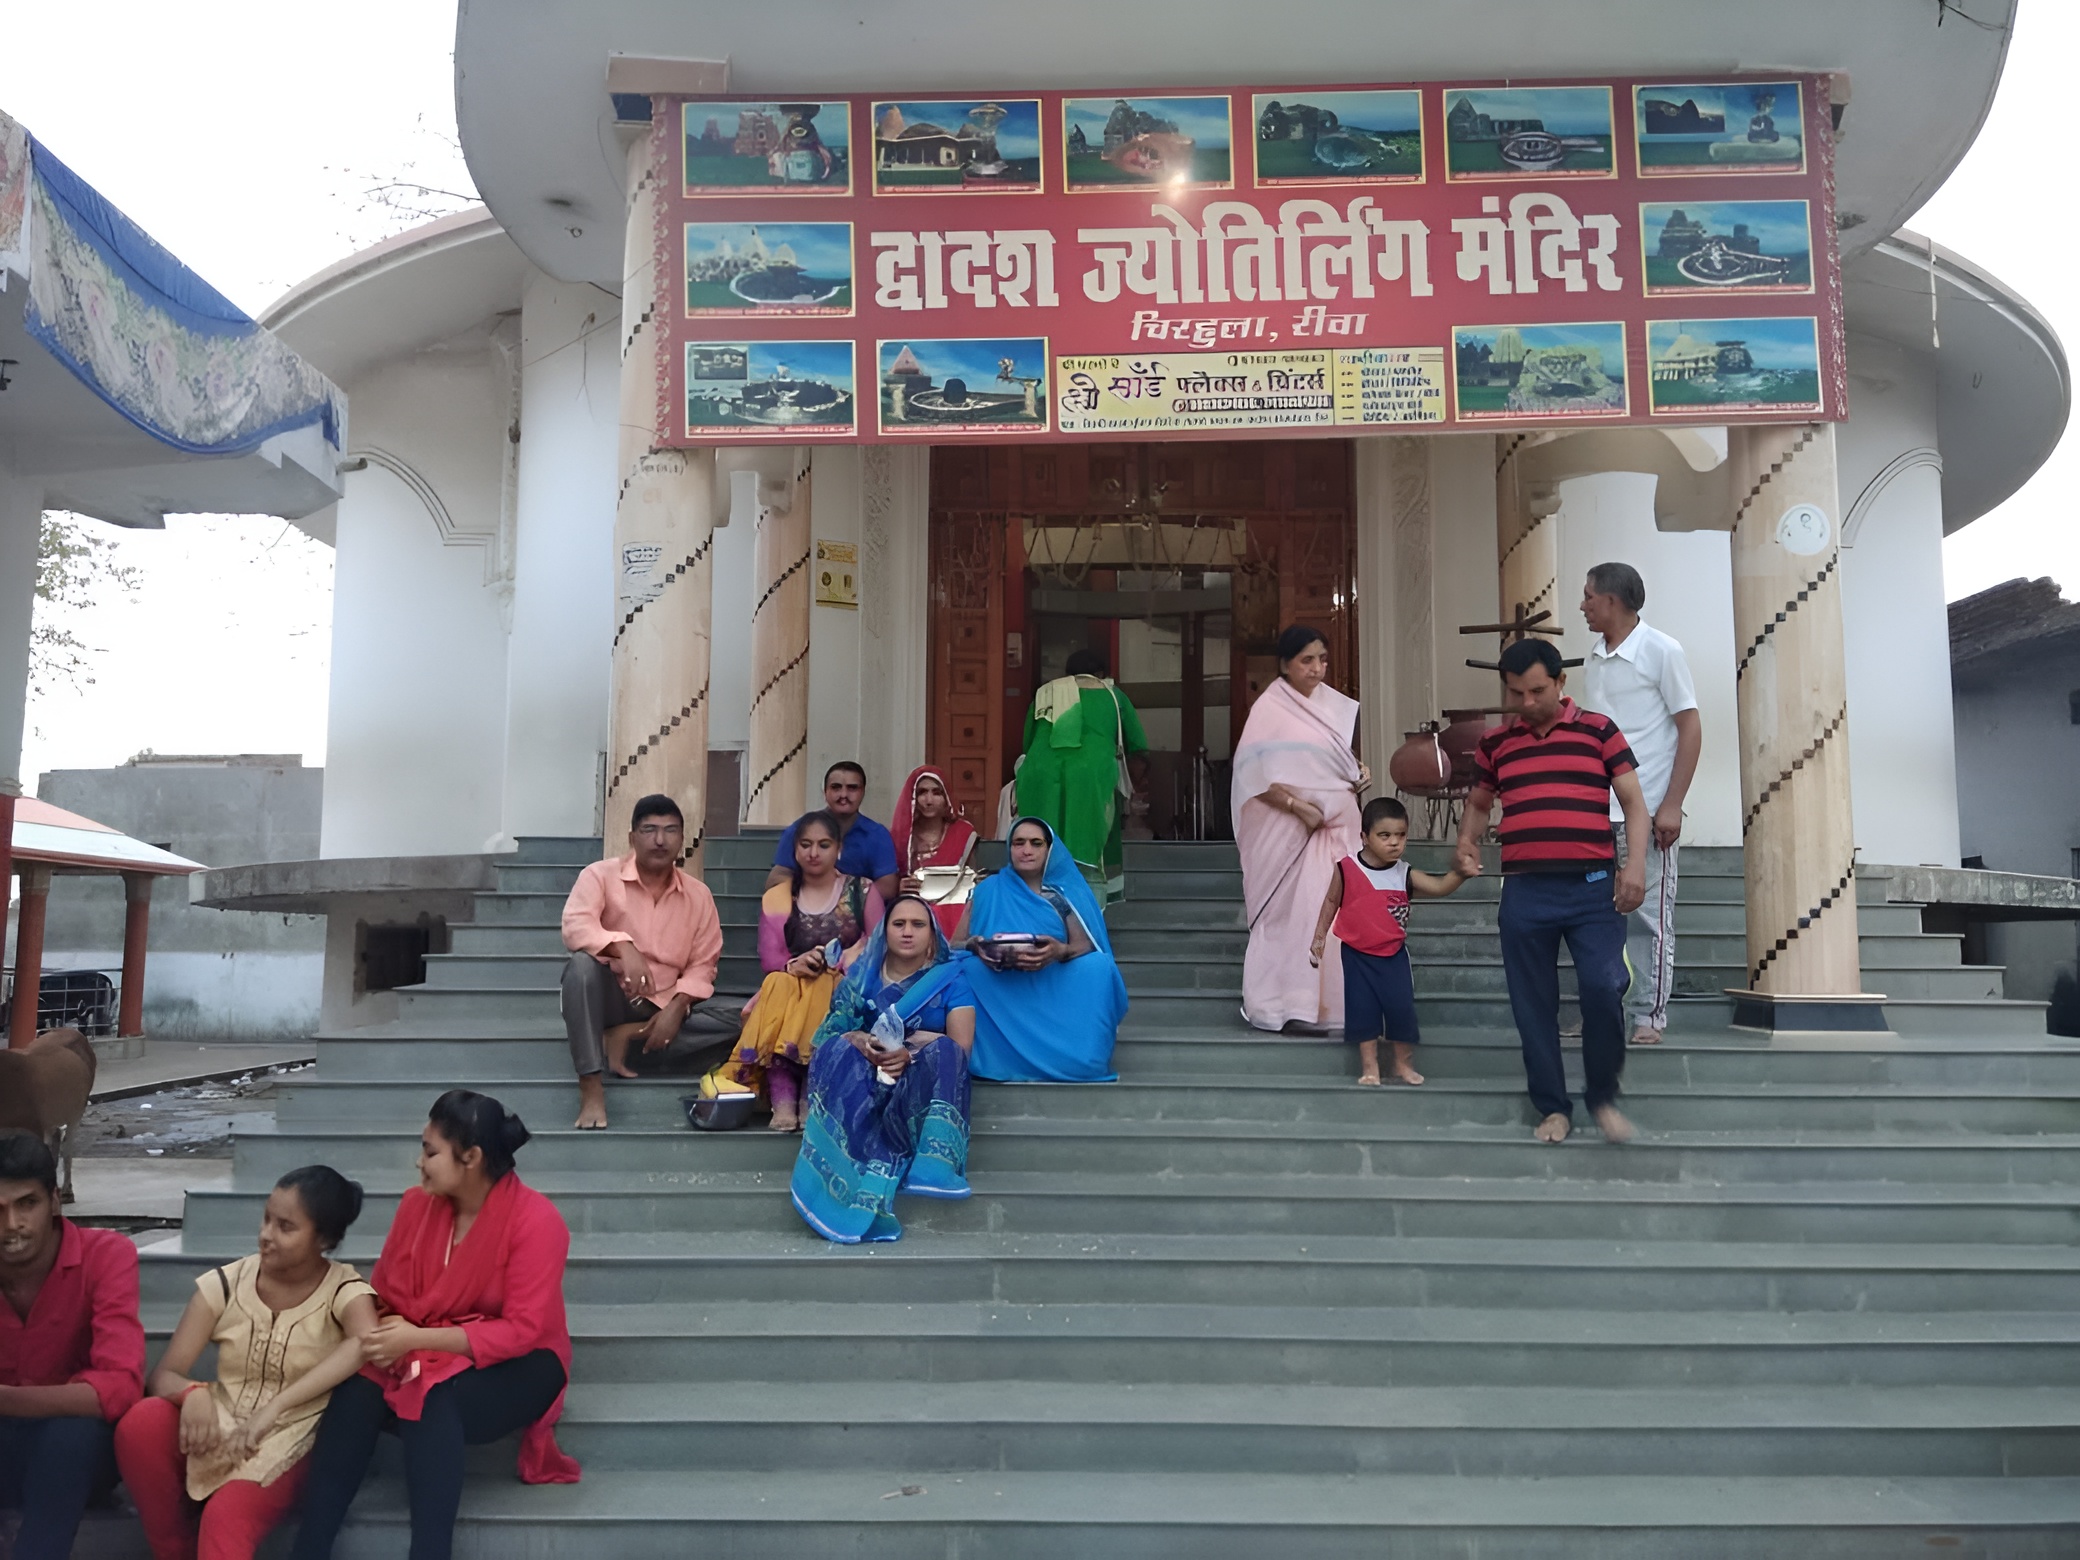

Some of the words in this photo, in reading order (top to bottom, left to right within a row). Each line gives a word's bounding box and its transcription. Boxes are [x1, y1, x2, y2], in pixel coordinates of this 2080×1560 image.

[870, 229, 1060, 311] द्वादश
[1077, 195, 1434, 304] ज्योतिर्लिंग
[1451, 192, 1624, 295] मंदिर
[1291, 305, 1370, 337] रीवा
